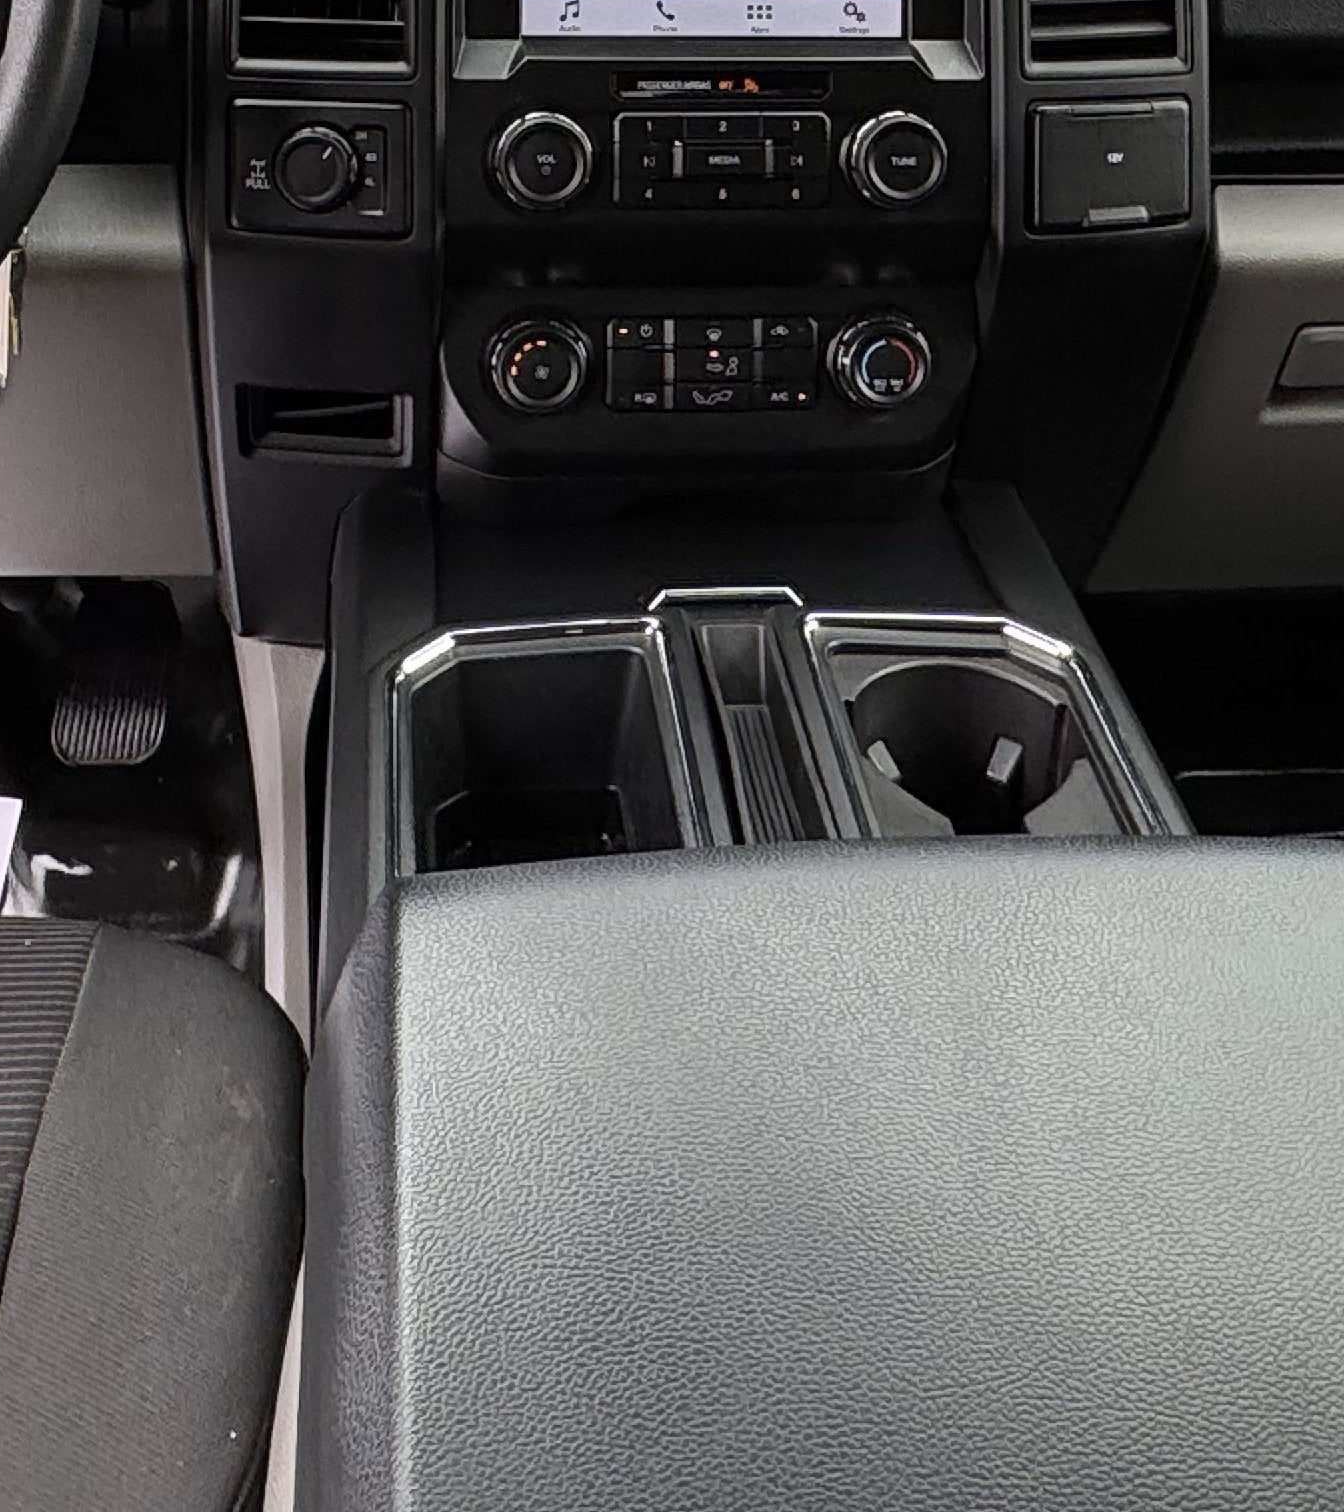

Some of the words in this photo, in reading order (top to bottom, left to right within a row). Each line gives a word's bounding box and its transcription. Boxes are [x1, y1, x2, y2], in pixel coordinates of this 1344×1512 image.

[719, 120, 728, 132] 2
[792, 120, 800, 132] 3
[536, 154, 557, 165] VOL
[708, 154, 741, 166] MEDIA
[890, 155, 918, 166] TUNE
